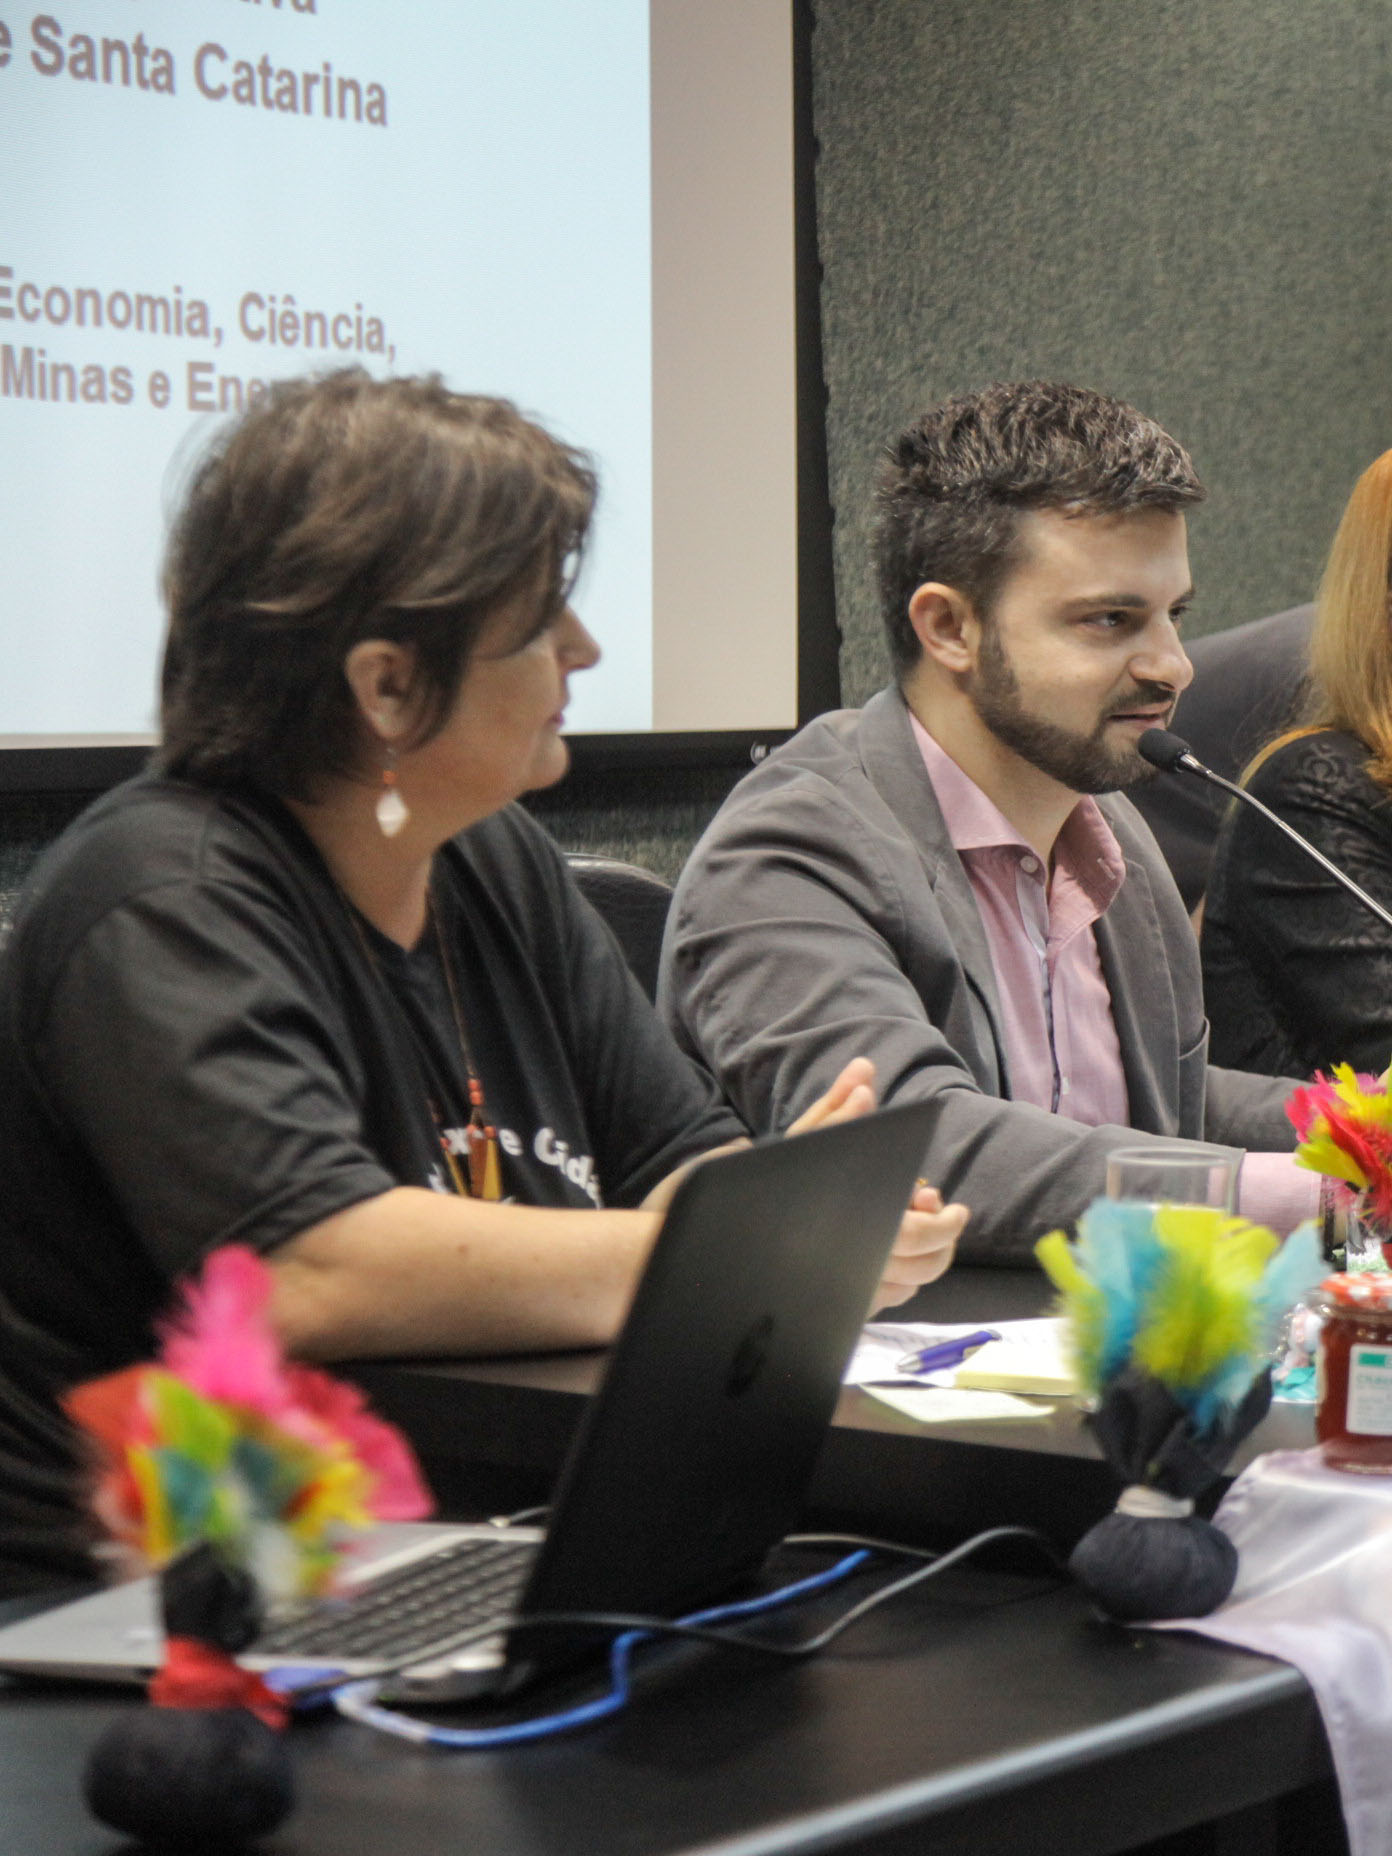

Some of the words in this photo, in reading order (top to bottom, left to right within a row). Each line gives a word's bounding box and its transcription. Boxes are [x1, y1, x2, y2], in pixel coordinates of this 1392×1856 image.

[30, 13, 175, 95] Santa
[194, 42, 388, 127] Catarina
[238, 290, 396, 361] Ciência,
[1, 344, 133, 405] Minas
[148, 370, 170, 409] e
